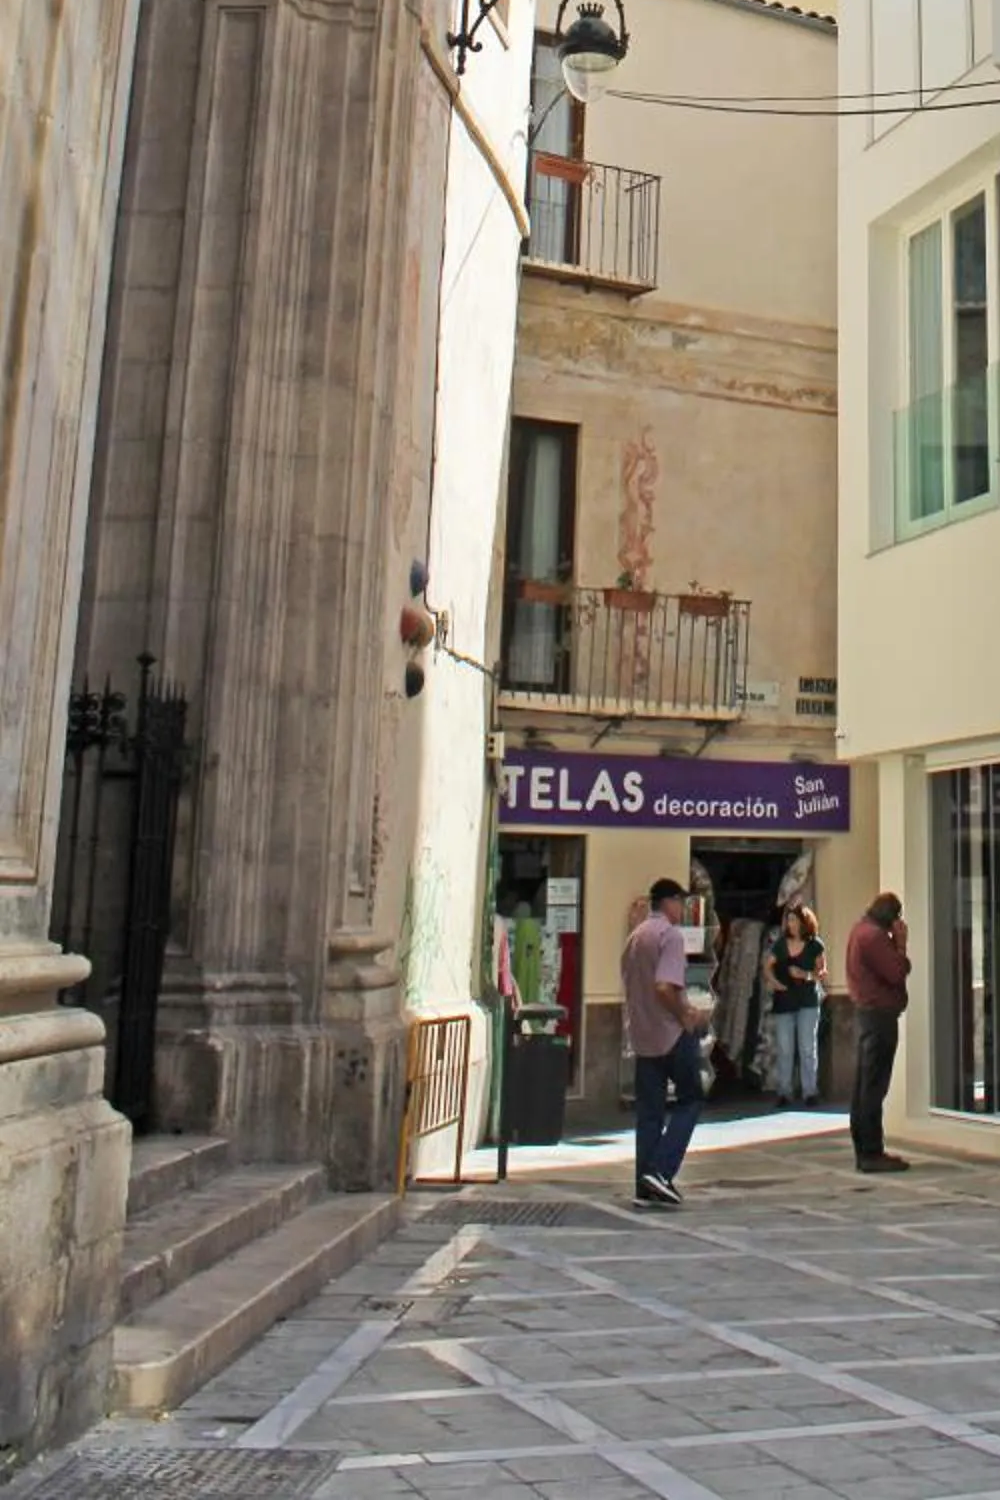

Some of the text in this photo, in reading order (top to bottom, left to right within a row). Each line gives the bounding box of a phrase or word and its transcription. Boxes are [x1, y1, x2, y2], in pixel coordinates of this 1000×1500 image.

[501, 765, 779, 818] TELAS decoración
[795, 775, 825, 795] San
[795, 794, 840, 819] Julián
